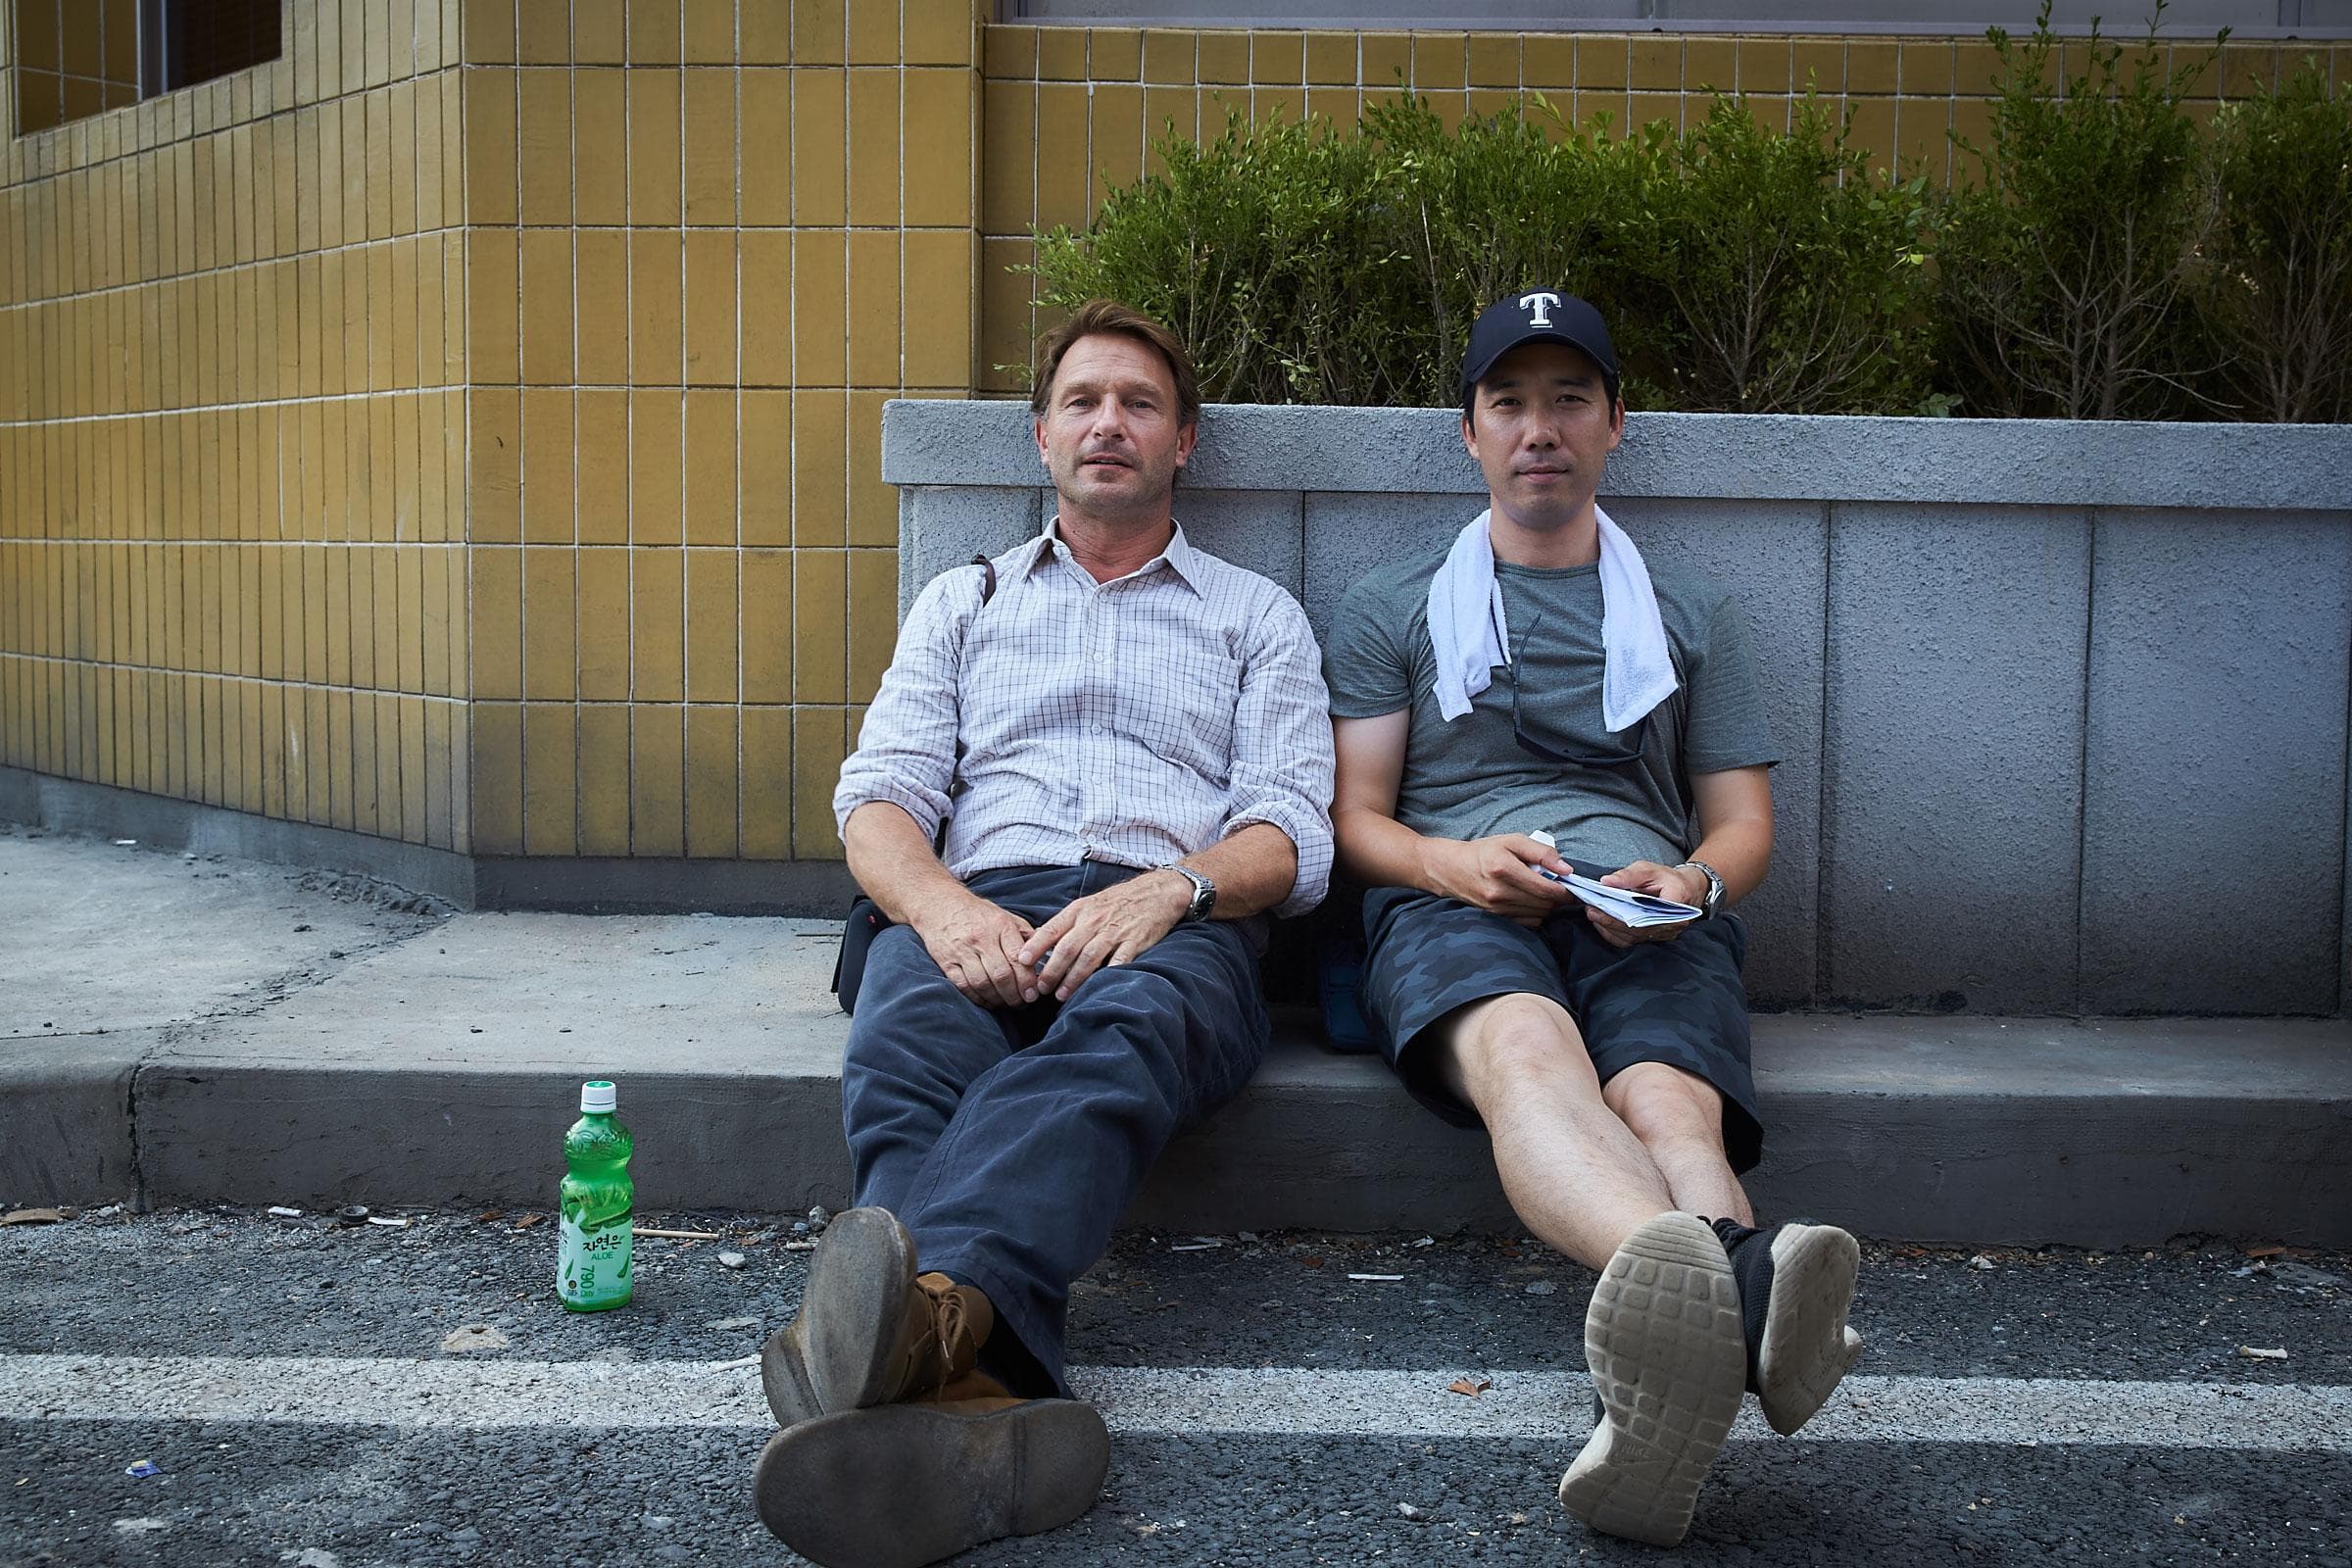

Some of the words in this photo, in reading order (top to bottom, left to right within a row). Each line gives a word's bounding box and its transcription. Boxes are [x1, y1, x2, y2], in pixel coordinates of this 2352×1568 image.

[1520, 292, 1561, 328] T
[582, 1234, 622, 1251] 자연은
[591, 1251, 613, 1260] ALOE
[580, 1264, 595, 1290] 790
